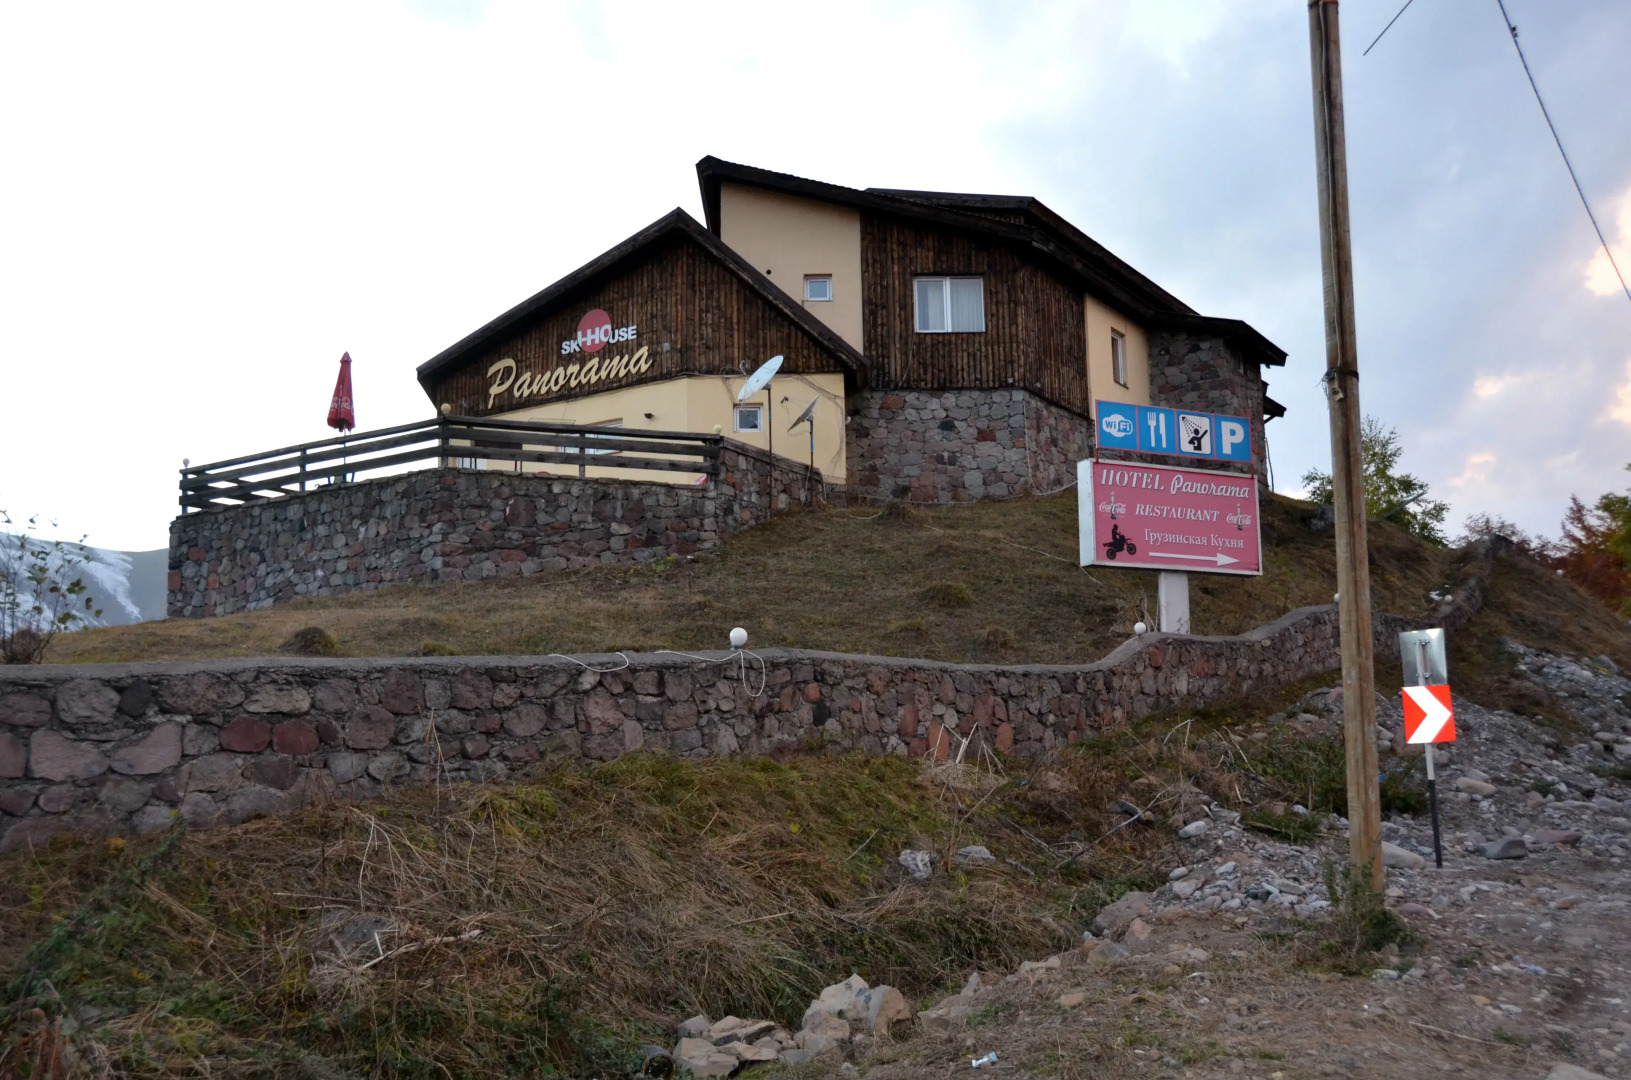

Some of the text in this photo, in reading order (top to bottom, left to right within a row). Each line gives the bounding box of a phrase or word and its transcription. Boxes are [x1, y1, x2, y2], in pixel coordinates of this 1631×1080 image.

[487, 345, 653, 410] Panorama
[1221, 420, 1245, 455] P
[1101, 469, 1250, 498] HOTEL Panorama
[1135, 503, 1220, 522] RESTAURANT
[1144, 528, 1244, 551] Грузинская Кухня
